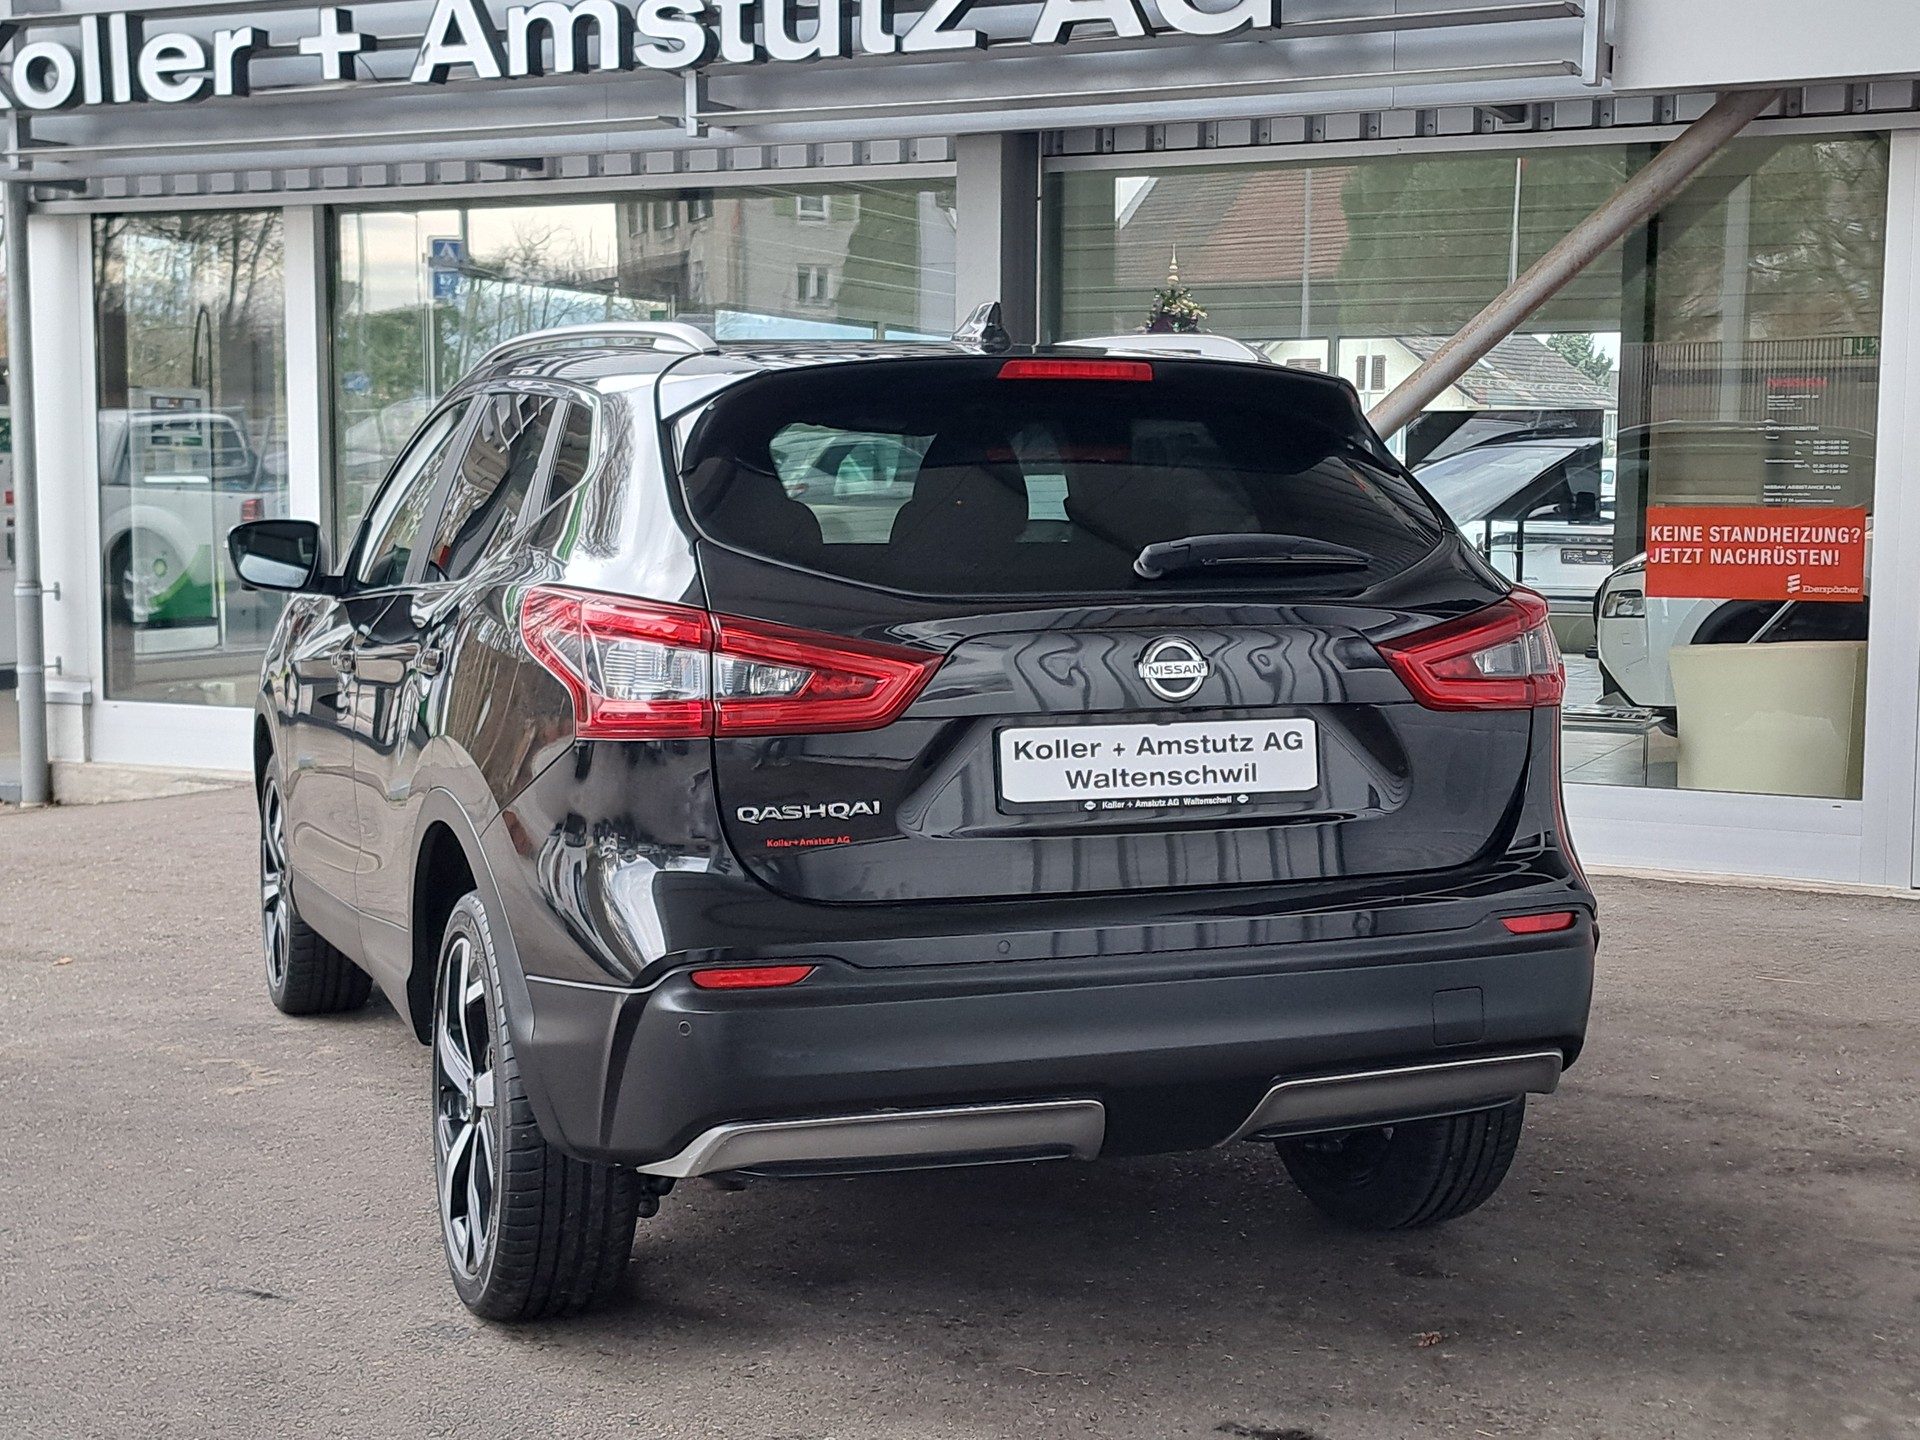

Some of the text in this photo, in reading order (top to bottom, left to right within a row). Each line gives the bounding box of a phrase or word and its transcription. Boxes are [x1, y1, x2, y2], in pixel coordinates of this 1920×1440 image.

[0, 11, 252, 110] oller
[299, 6, 363, 81] +
[410, 0, 977, 84] Amstutz
[1650, 525, 1861, 544] KEINE STANDHEIZUNG?
[1649, 545, 1840, 566] JETZT NACHRÜSTEN!
[1148, 664, 1202, 677] NISSAN
[1013, 730, 1303, 761] Koller + Amstutz AG
[1065, 763, 1257, 790] Waltenschwil
[737, 800, 881, 824] QASHQAI
[1102, 801, 1125, 809] Koller
[1135, 799, 1166, 808] Amstutz
[1167, 798, 1179, 806] AG
[1183, 796, 1232, 805] Waltenschwil
[837, 836, 850, 844] AG
